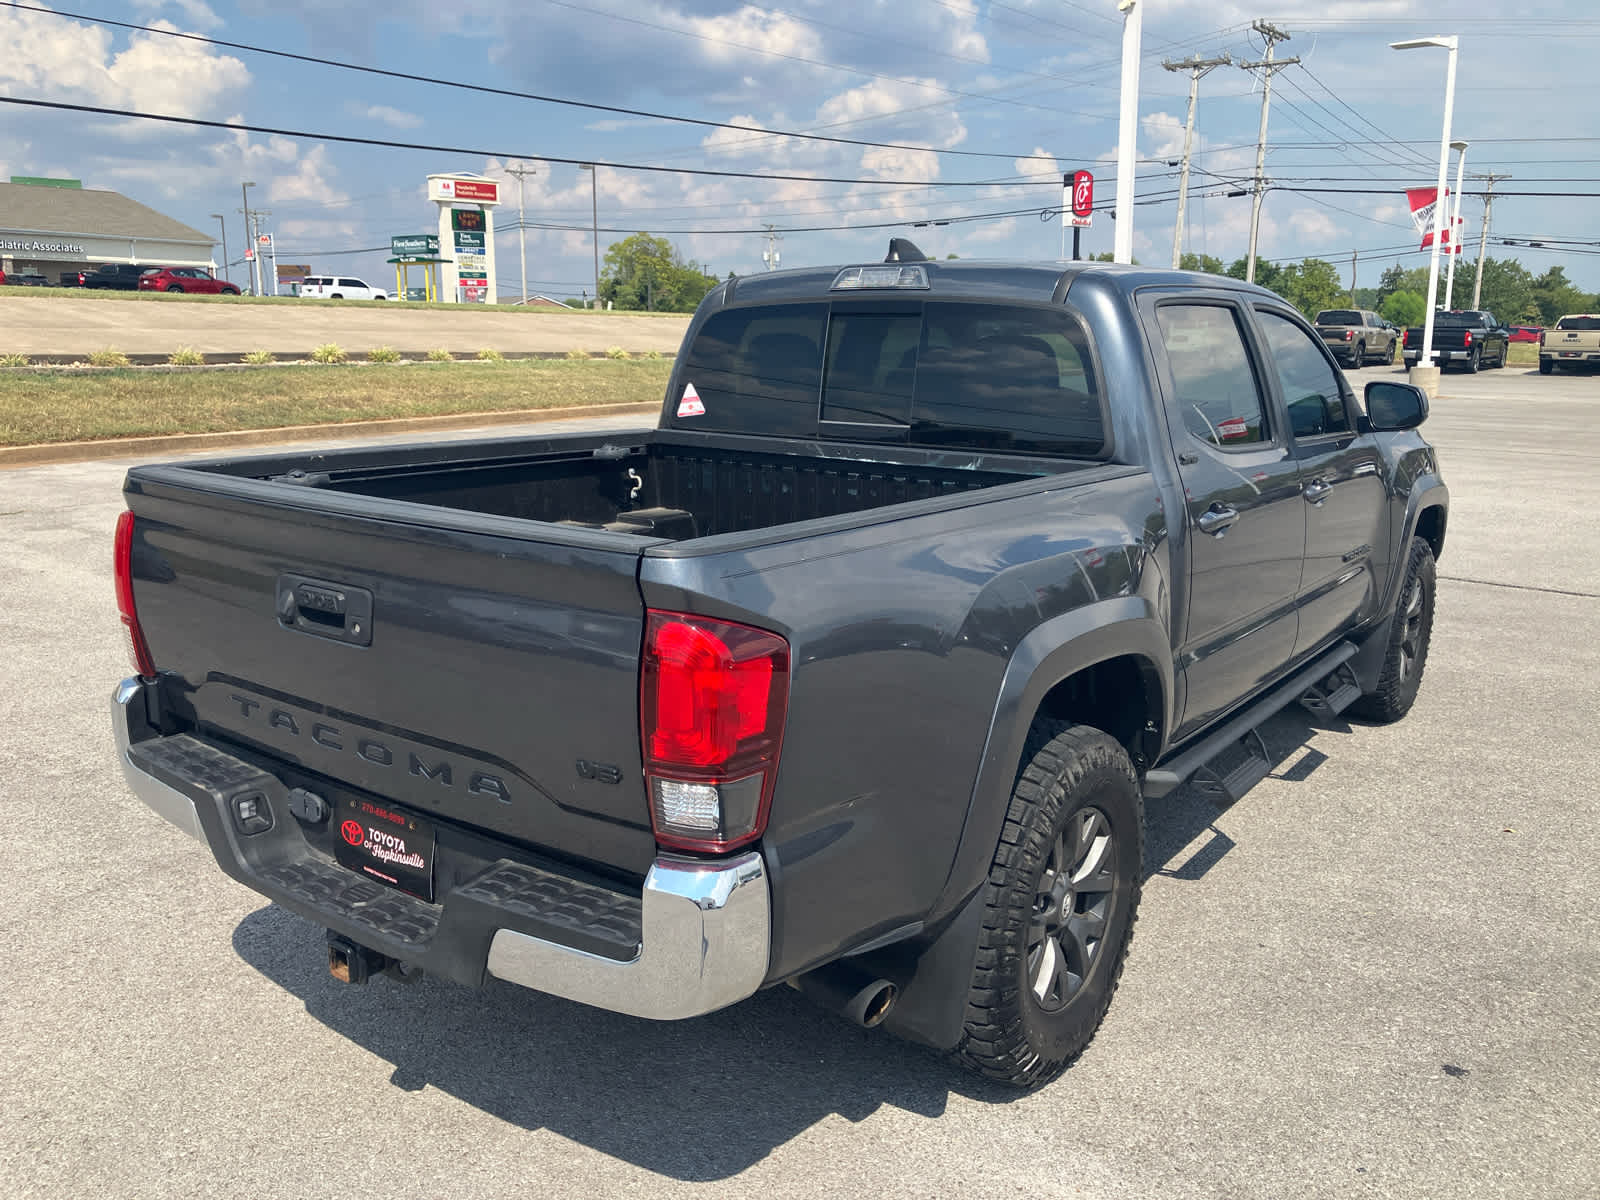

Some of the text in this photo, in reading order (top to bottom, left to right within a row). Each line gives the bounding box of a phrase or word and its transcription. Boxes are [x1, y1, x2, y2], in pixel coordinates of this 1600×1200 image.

[32, 241, 85, 253] Associates
[227, 693, 513, 805] TACOMA
[369, 827, 405, 853] TOYOTA
[371, 843, 425, 869] Hopkinsville
